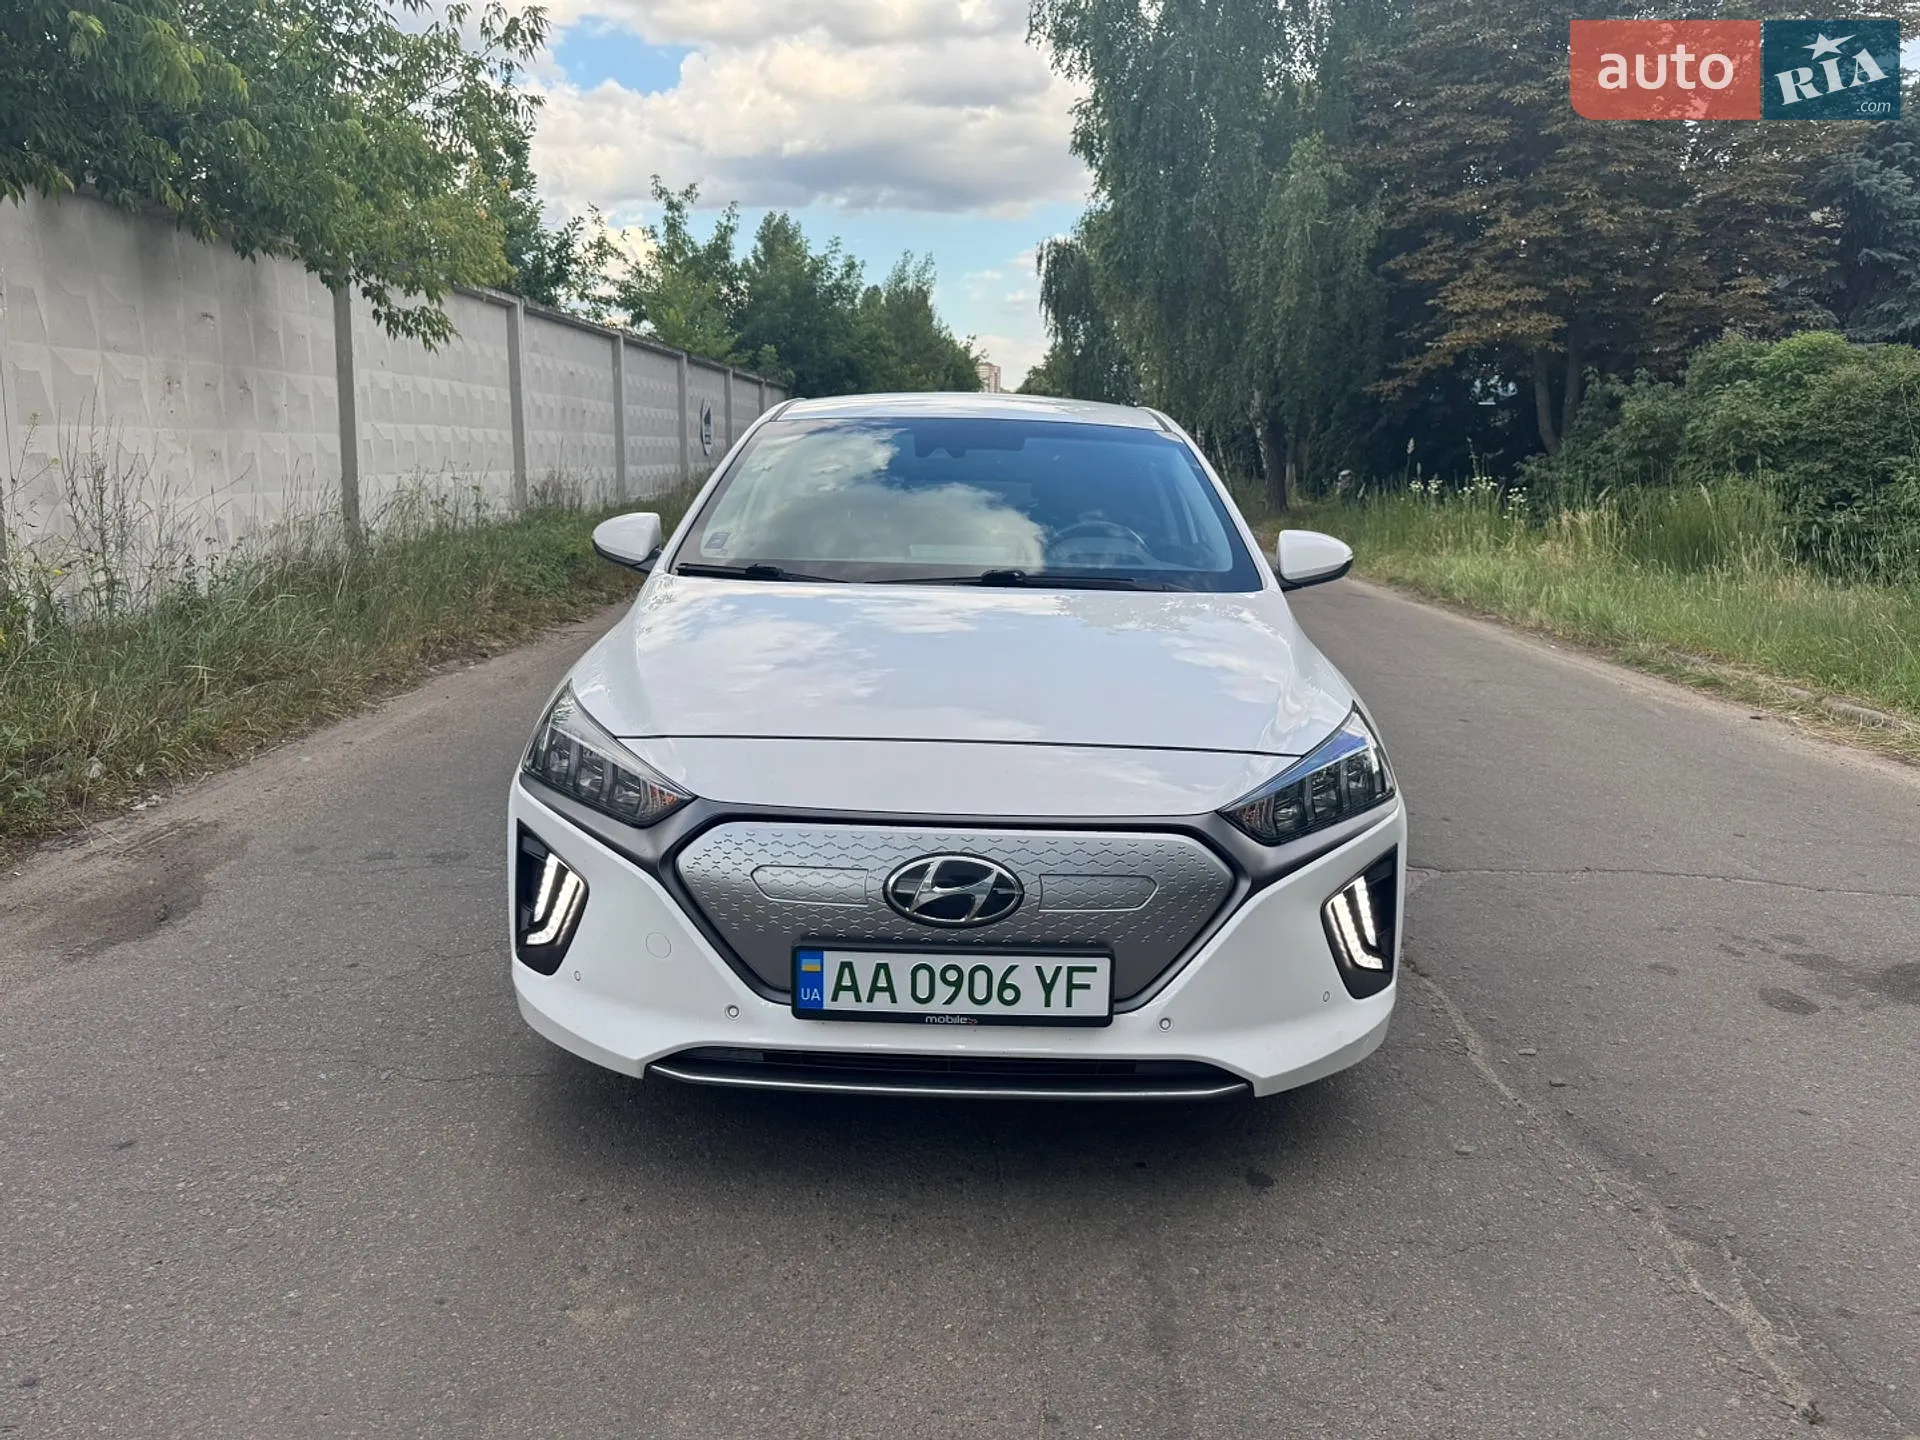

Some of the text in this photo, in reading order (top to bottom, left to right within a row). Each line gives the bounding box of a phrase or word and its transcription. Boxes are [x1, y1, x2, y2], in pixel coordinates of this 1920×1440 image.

[801, 987, 821, 1001] UA
[831, 961, 1098, 1008] AA 0906 YF
